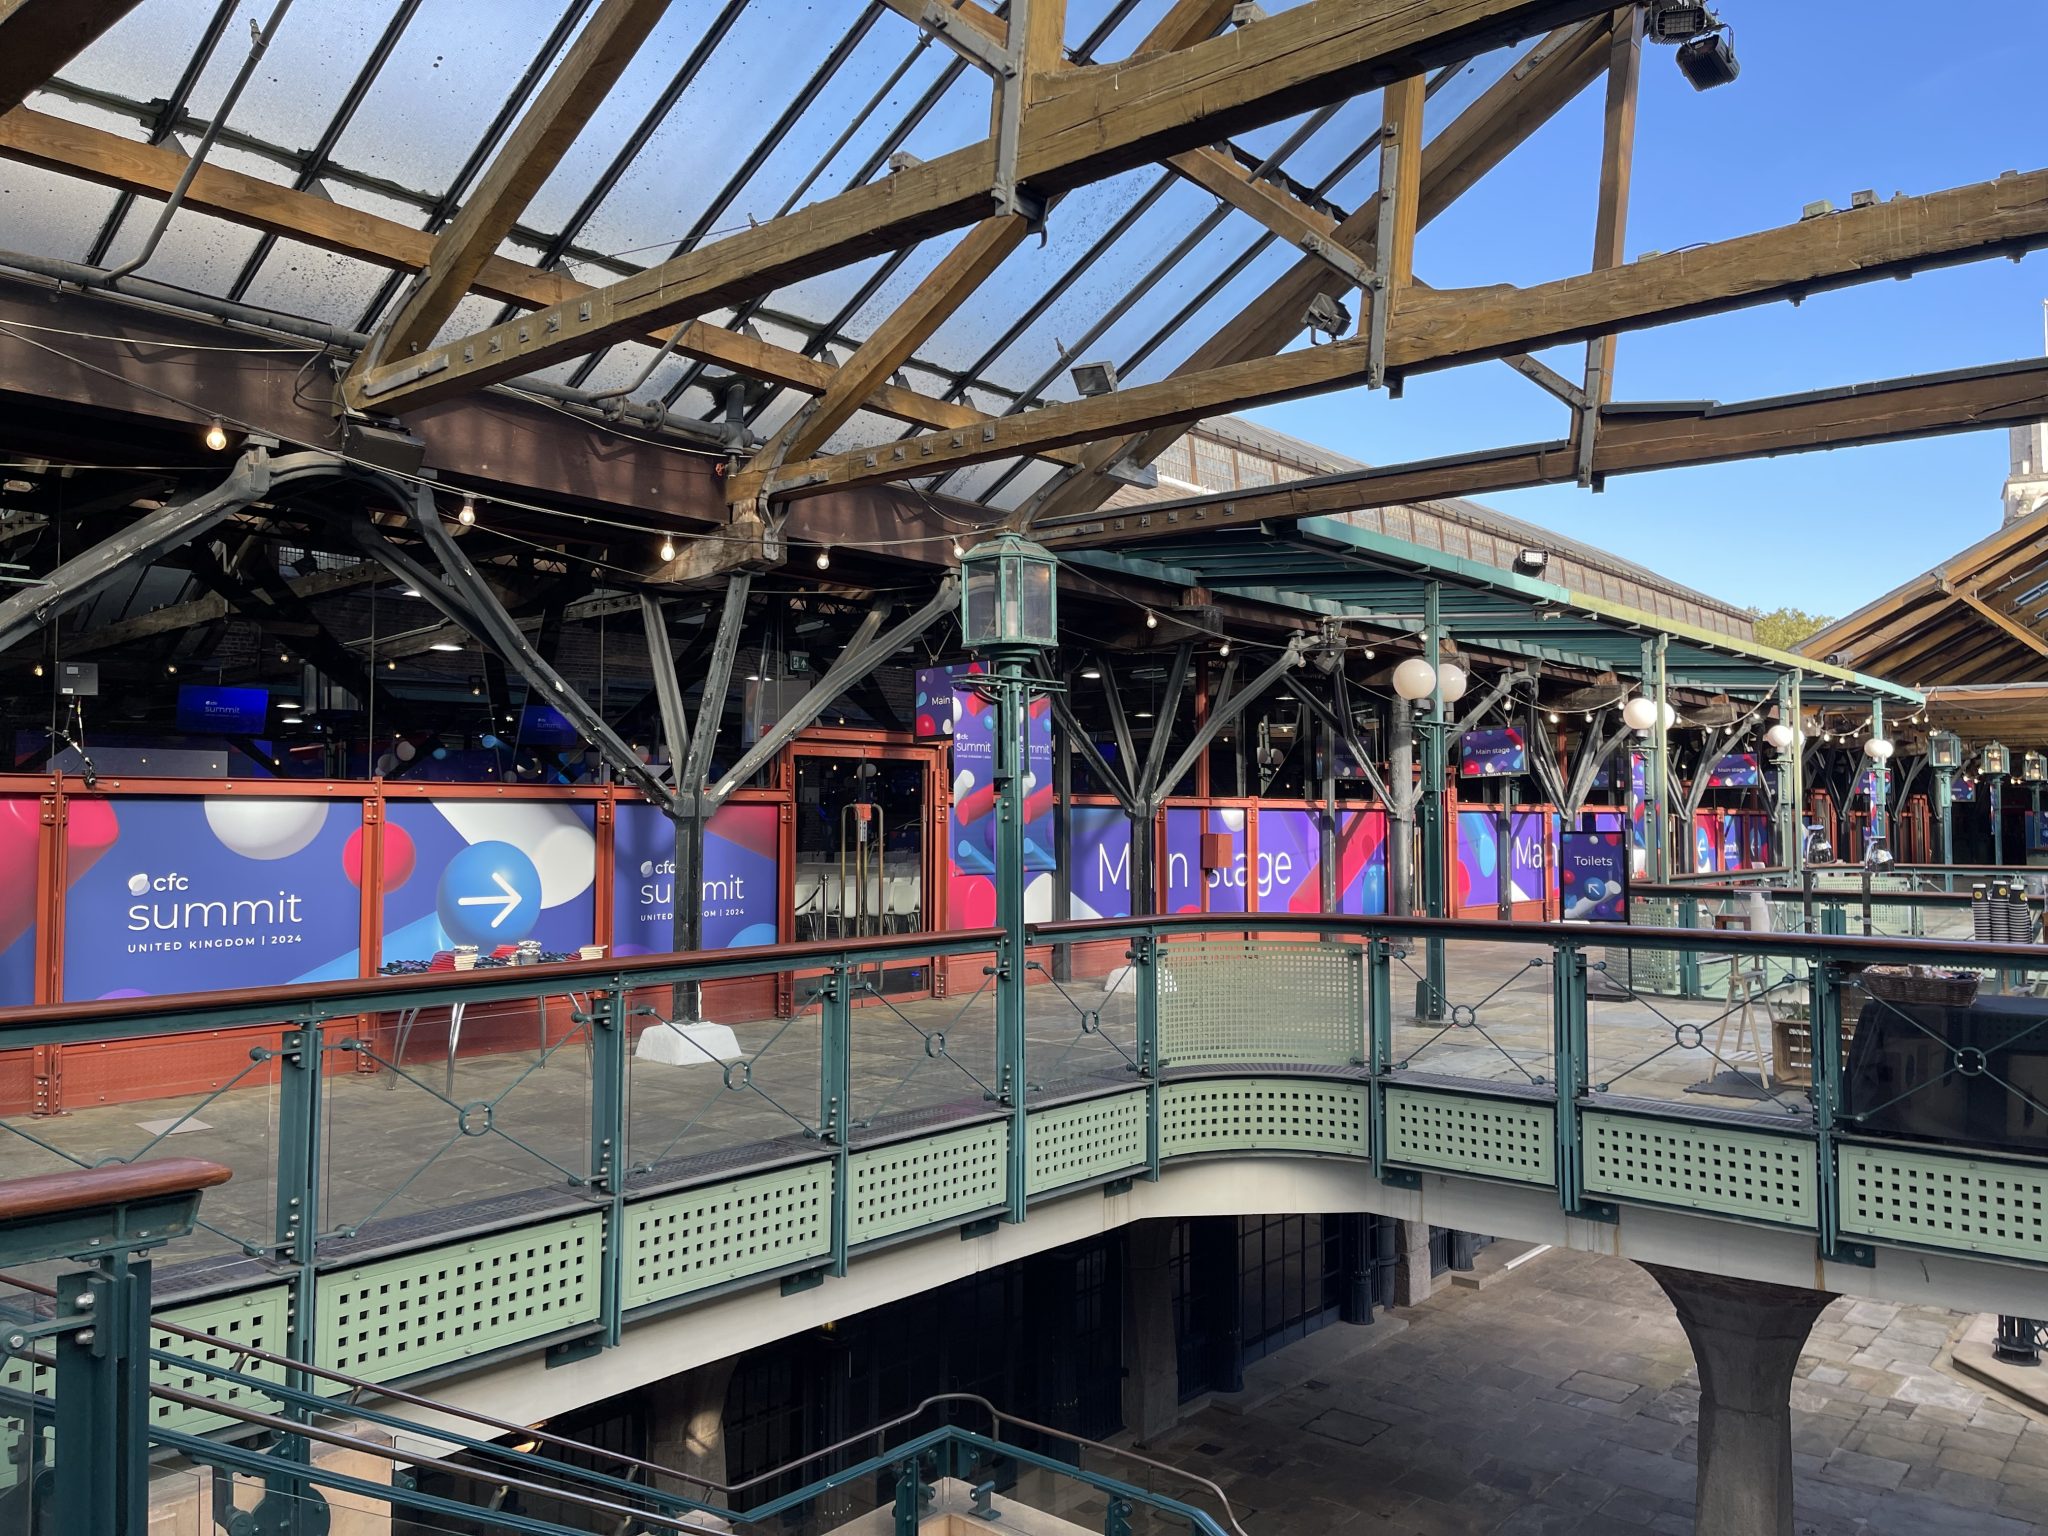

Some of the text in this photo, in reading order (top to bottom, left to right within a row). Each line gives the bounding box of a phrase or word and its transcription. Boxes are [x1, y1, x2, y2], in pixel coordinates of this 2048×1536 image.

[931, 696, 951, 706] Main
[204, 706, 241, 714] summit
[1019, 743, 1051, 754] smmit
[1492, 747, 1510, 755] stage
[1515, 836, 1558, 869] Man
[655, 860, 676, 875] cfc
[1099, 842, 1188, 892] Mn
[1573, 856, 1613, 866] Toilets
[153, 872, 189, 892] cfc
[640, 874, 745, 905] sumit
[127, 890, 303, 931] summit
[640, 912, 673, 922] UNITED
[725, 908, 745, 916] 2024
[127, 941, 183, 953] UNITED
[189, 937, 256, 950] KINGDOM
[271, 934, 302, 945] 2024
